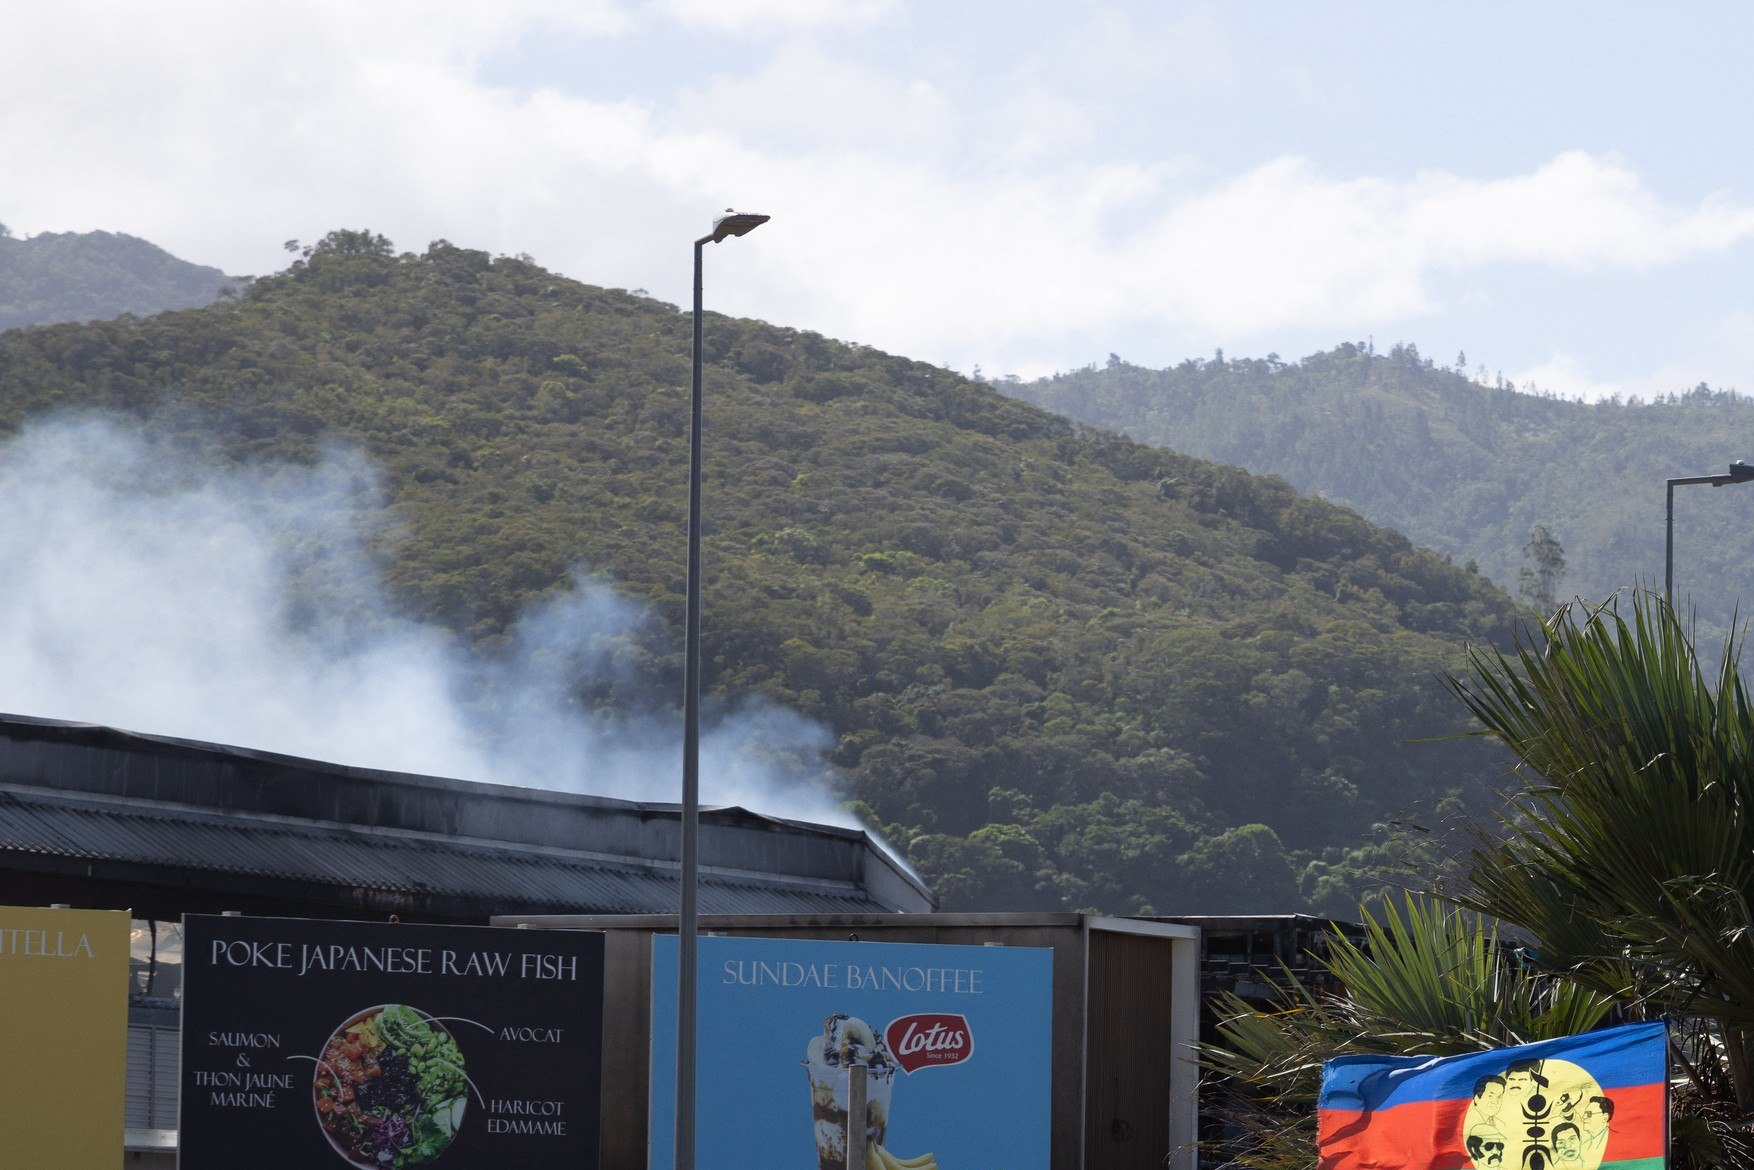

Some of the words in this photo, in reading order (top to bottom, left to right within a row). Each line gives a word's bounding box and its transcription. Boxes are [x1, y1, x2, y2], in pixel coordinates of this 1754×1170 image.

[0, 928, 94, 958] TELLA
[211, 939, 292, 968] POKE
[298, 944, 433, 976] JAPANESE
[441, 949, 513, 977] RAW
[521, 953, 578, 981] FISH
[723, 960, 838, 989] SUNDAE
[846, 964, 984, 995] BANOFFEE
[208, 1031, 280, 1048] SAUMON
[500, 1027, 564, 1043] AVOCAT
[898, 1022, 964, 1055] Lotus
[236, 1052, 251, 1067] &
[193, 1071, 241, 1087] THON
[244, 1072, 294, 1091] JAUNE
[210, 1090, 276, 1108] MARINÉ
[491, 1099, 565, 1116] HARICOT
[487, 1118, 567, 1136] EDAMAME
